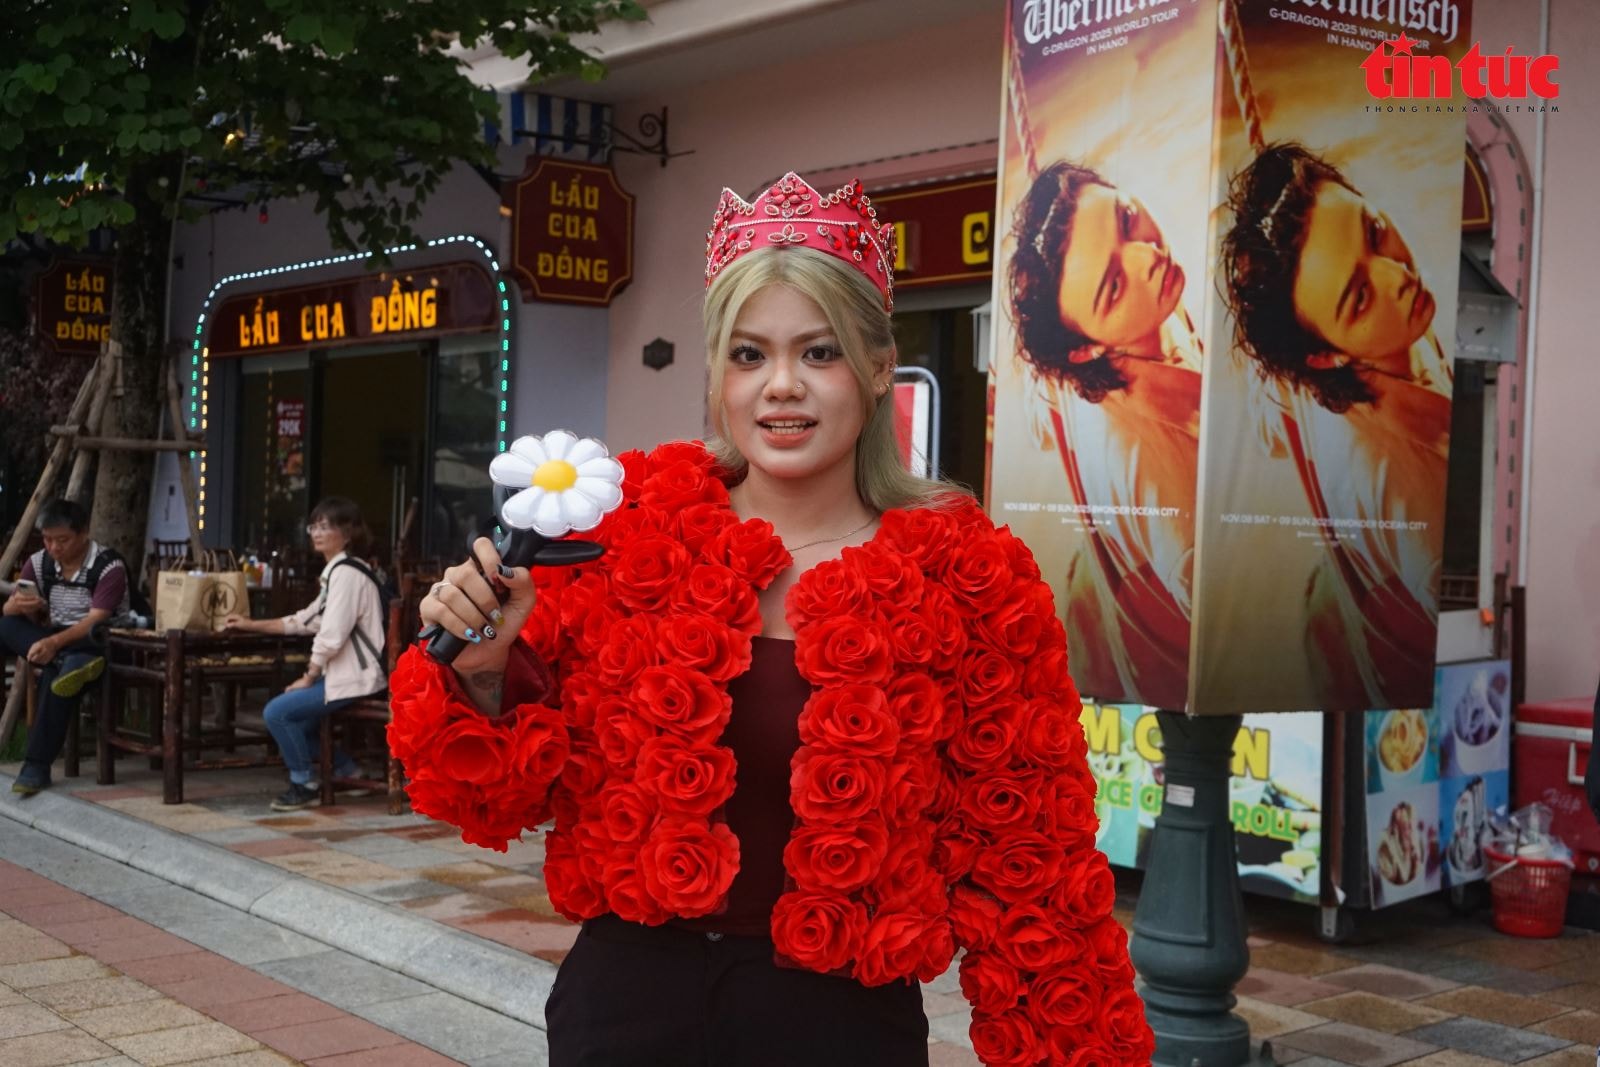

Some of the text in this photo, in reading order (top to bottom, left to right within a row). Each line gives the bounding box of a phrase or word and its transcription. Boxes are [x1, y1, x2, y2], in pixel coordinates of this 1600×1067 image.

[1042, 8, 1179, 56] G-DRAGON 2025 WORLD TOUR
[1269, 8, 1329, 29] G-DRAGON
[1331, 21, 1358, 35] 2025
[1360, 27, 1399, 42] WORLD
[1327, 33, 1340, 45] IN
[1086, 35, 1128, 56] IN HANOI
[548, 212, 597, 241] CUA
[537, 244, 608, 283] ĐỒNG
[65, 294, 104, 314] CUA
[301, 301, 345, 341] CUA
[371, 278, 437, 333] ĐỒNG
[1160, 507, 1180, 517] CITY
[1378, 520, 1408, 531] OCEAN
[1409, 521, 1429, 531] CITY
[1231, 800, 1299, 842] ROLL
